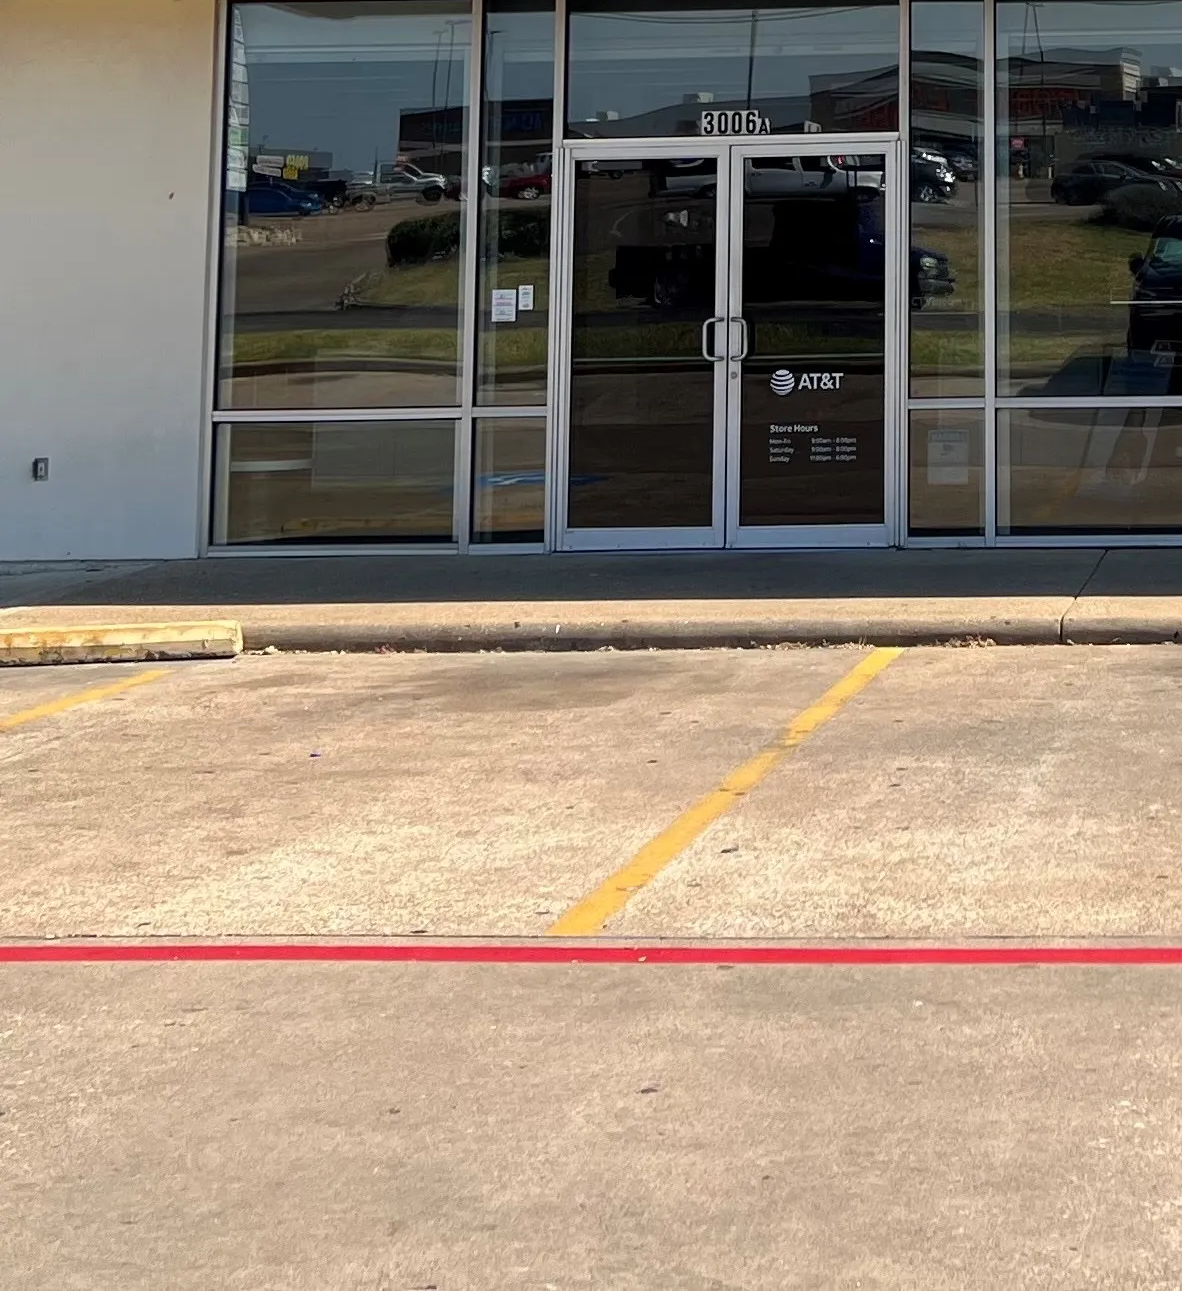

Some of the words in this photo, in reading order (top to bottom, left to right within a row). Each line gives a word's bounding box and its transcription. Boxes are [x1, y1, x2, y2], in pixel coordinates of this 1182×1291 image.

[798, 372, 844, 390] AT&T
[769, 424, 793, 433] Store
[794, 424, 818, 433] Hours
[769, 455, 790, 463] Sunday
